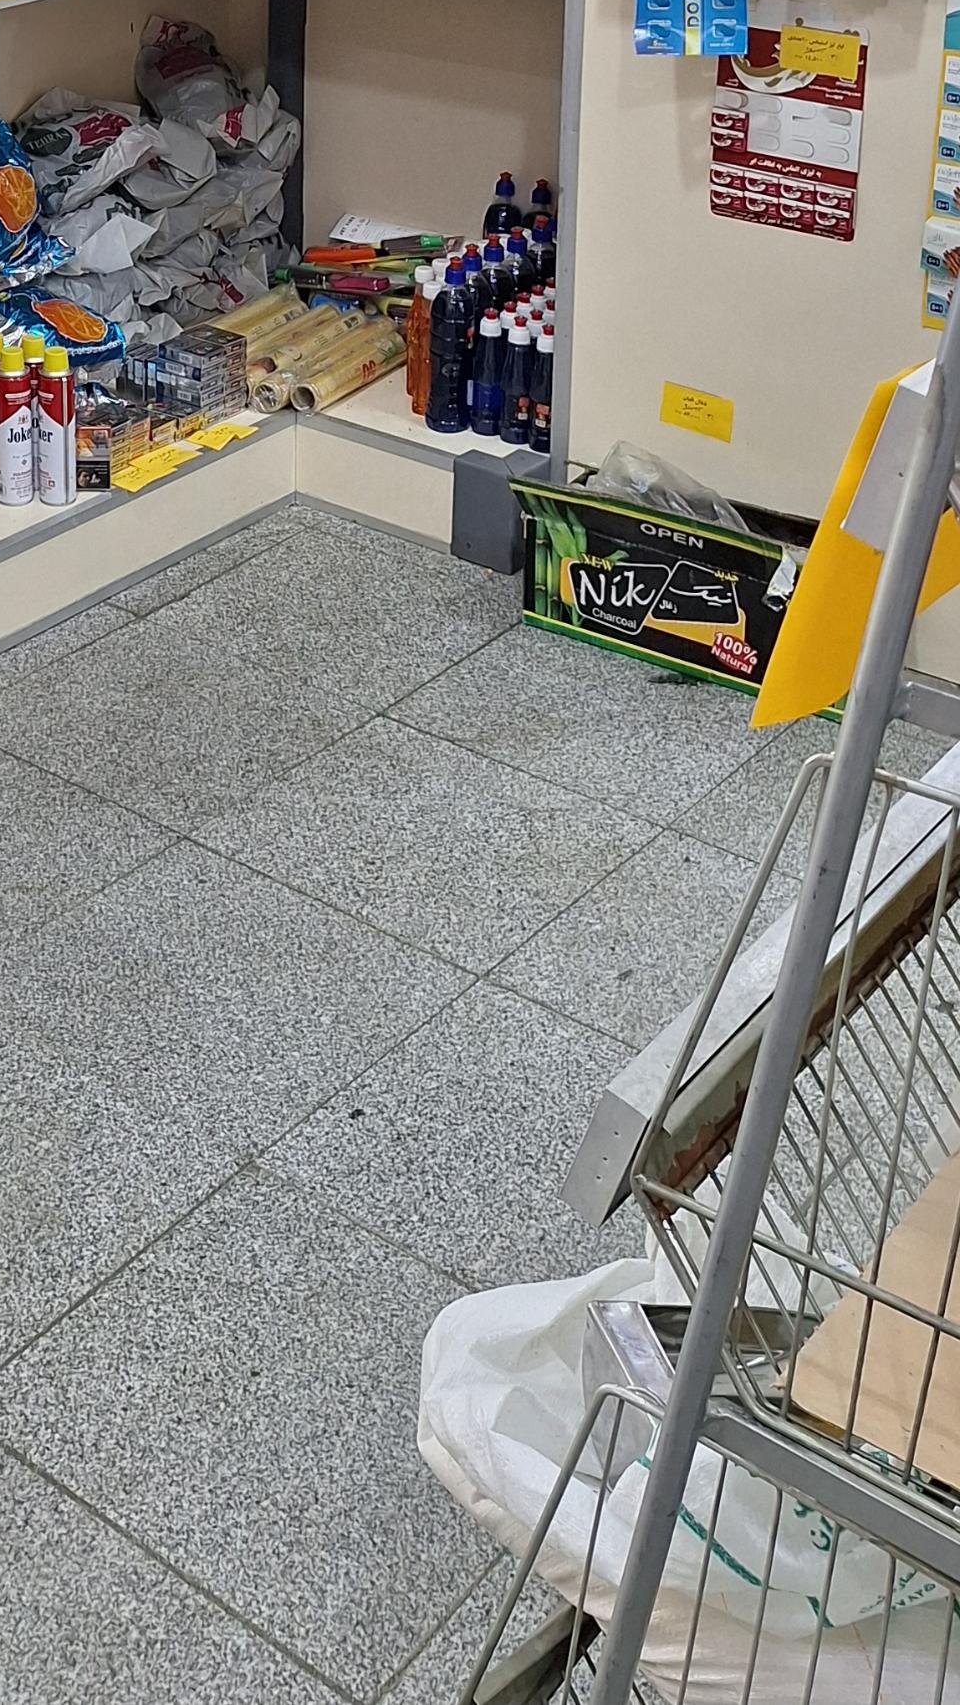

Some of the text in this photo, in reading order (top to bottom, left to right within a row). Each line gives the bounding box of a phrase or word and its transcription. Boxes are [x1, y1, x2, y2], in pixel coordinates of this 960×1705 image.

[640, 523, 704, 550] OPEN
[581, 552, 617, 572] NEW
[578, 568, 656, 608] Nik
[592, 606, 637, 631] Charcoal
[711, 644, 754, 675] Natural
[715, 630, 759, 665] 100%
